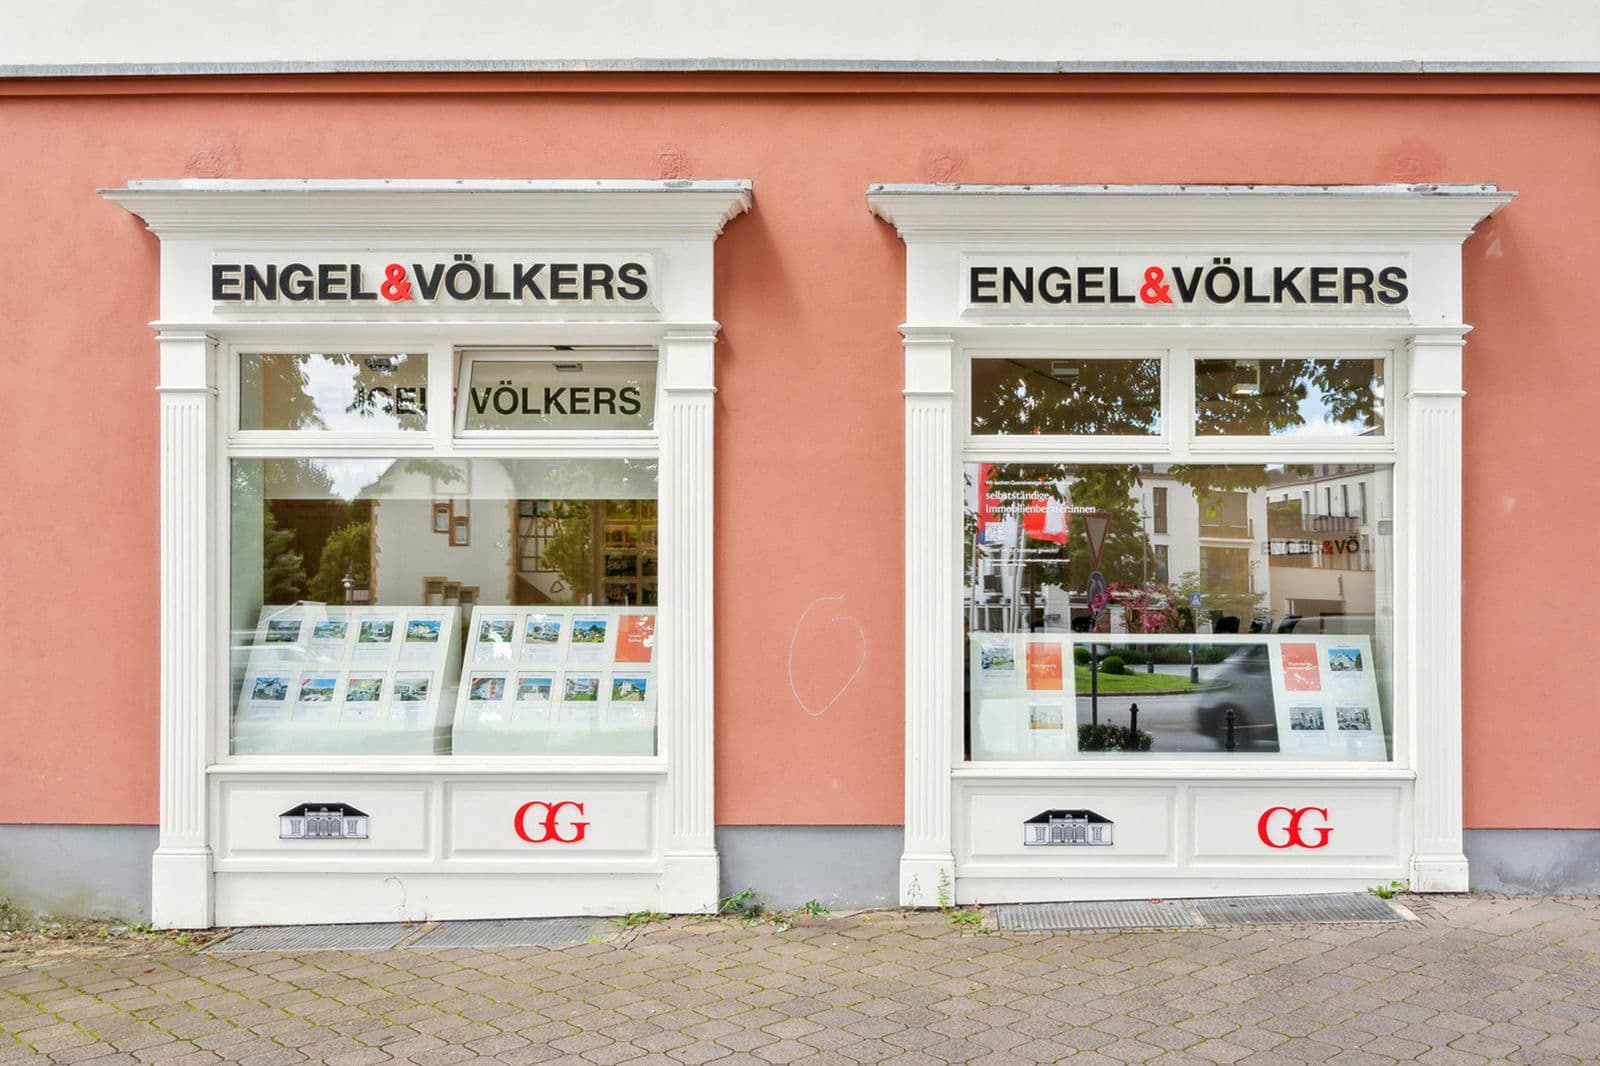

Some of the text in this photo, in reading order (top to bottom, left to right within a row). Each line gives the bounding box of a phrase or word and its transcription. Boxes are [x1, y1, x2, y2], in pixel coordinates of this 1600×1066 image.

[212, 254, 648, 301] ENGEL&VÖLKERS
[970, 257, 1409, 304] ENGEL&VÖLKERS
[470, 380, 641, 415] VÖLKERS
